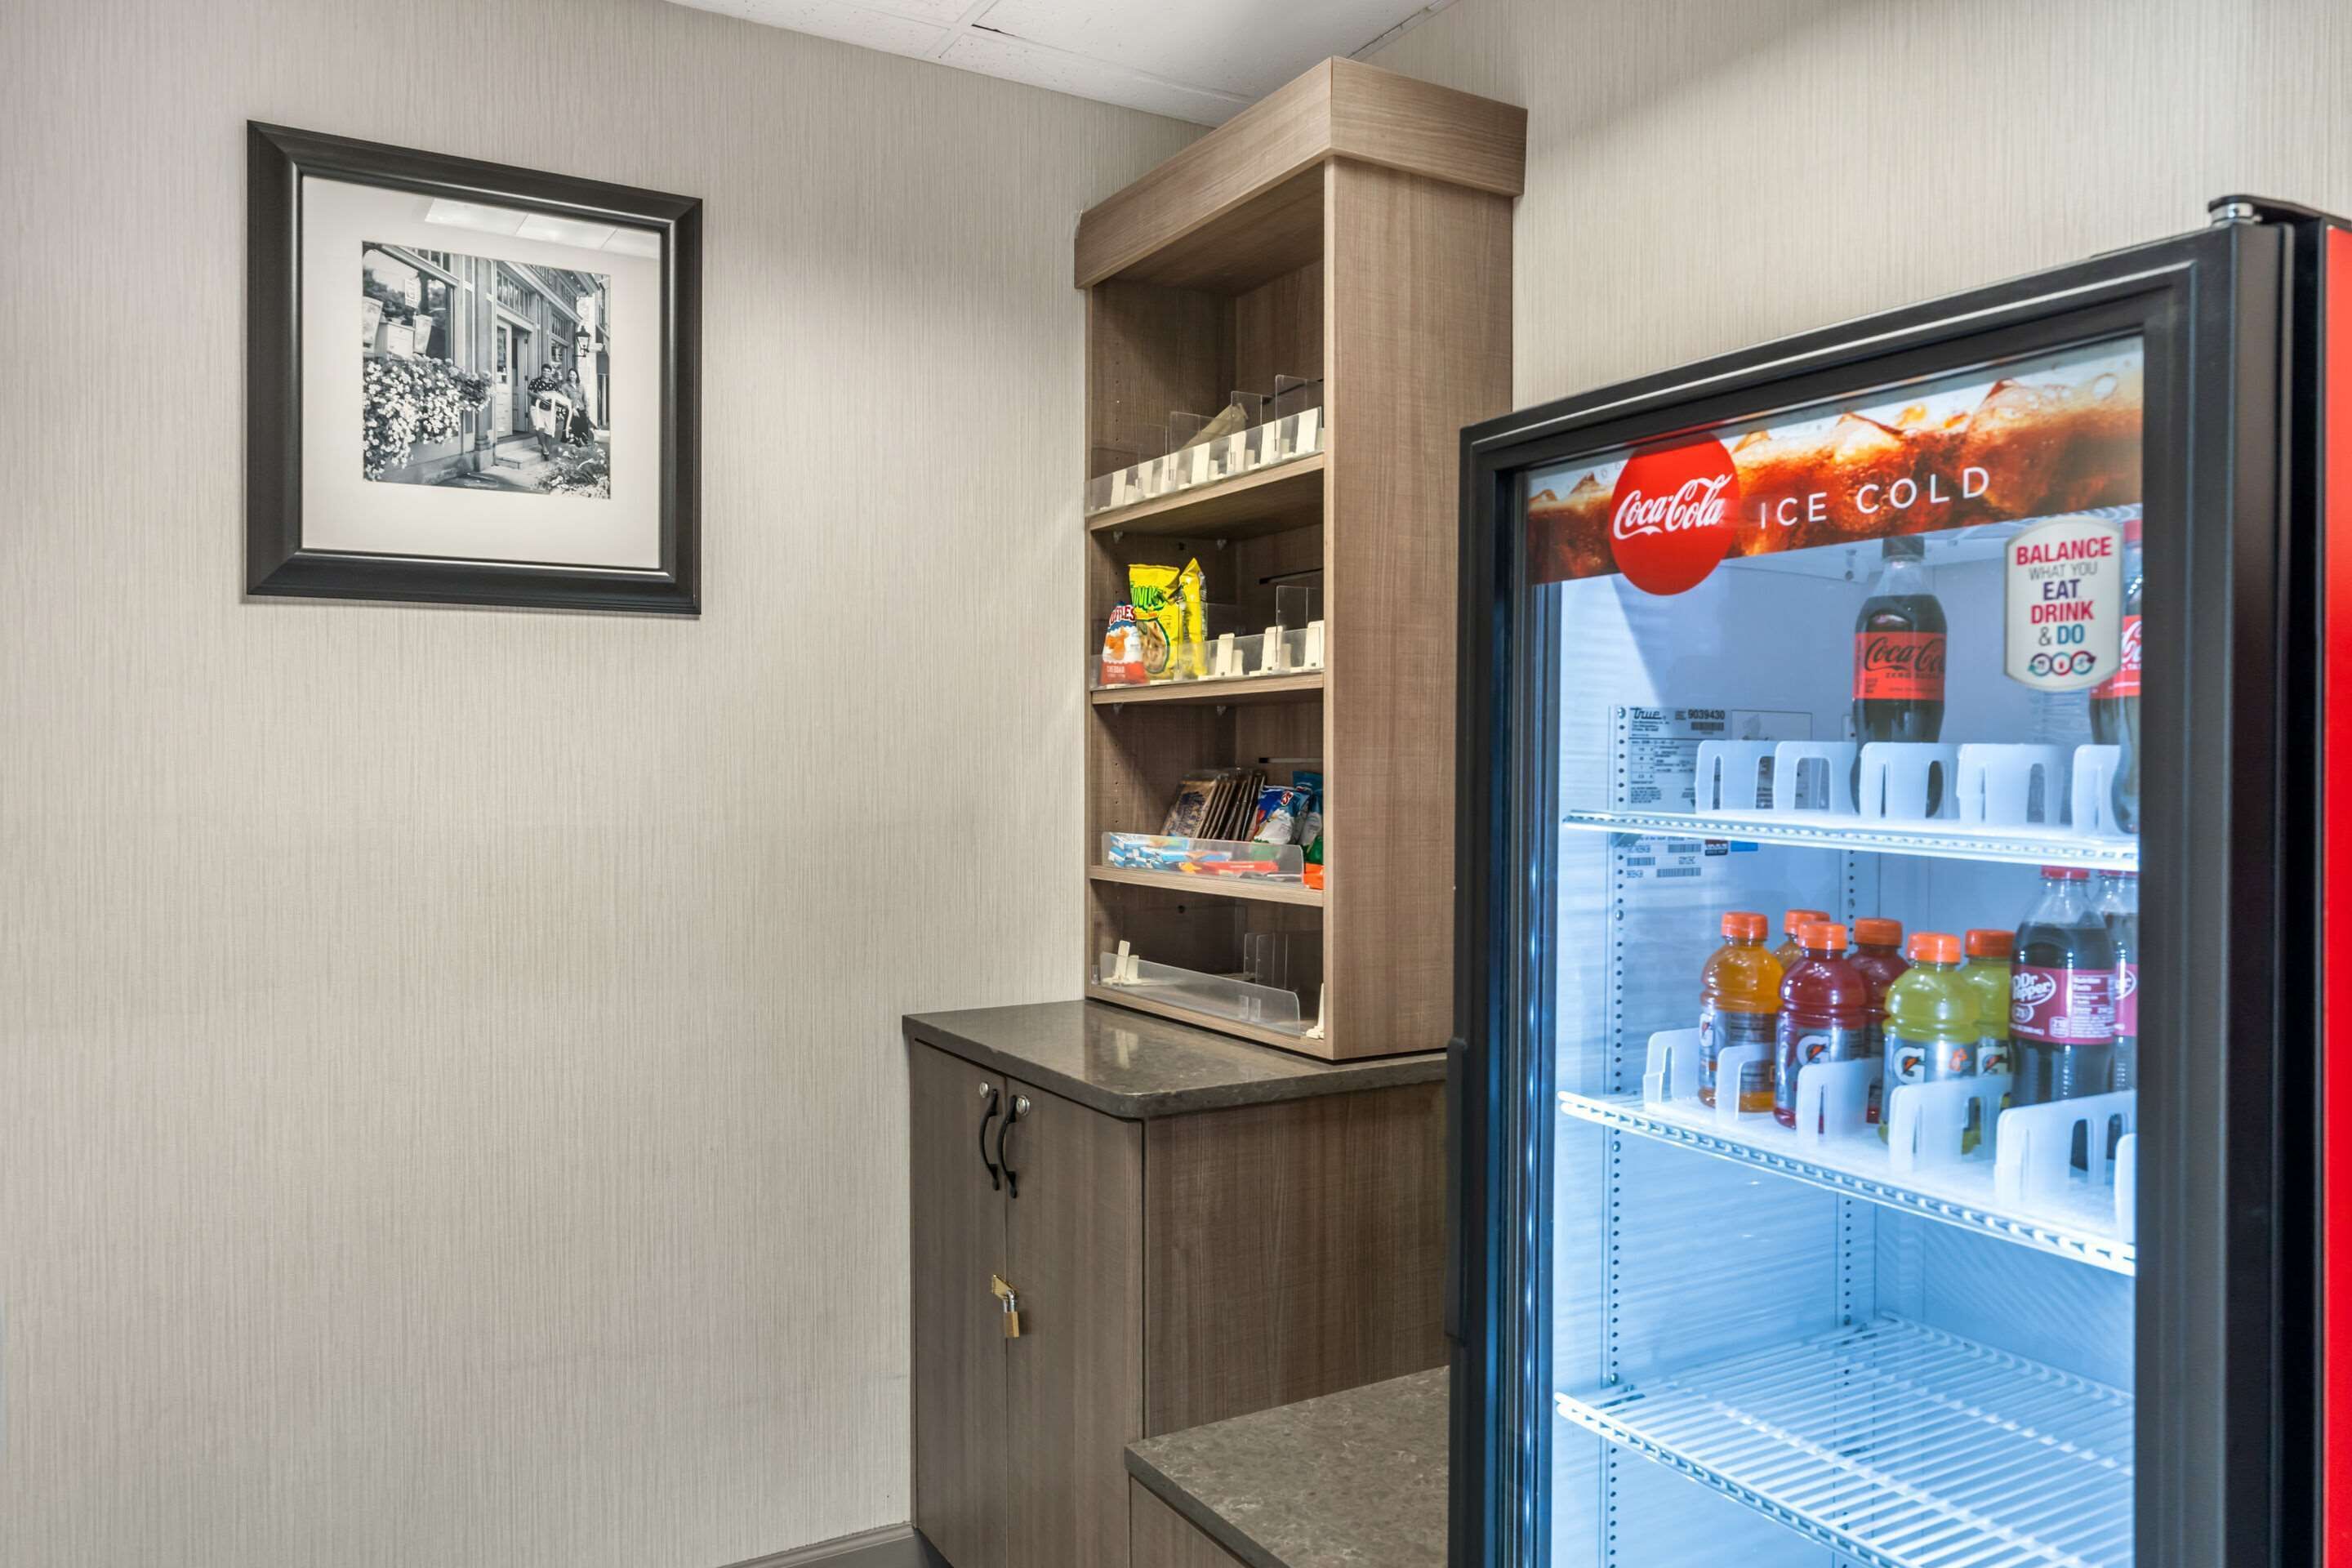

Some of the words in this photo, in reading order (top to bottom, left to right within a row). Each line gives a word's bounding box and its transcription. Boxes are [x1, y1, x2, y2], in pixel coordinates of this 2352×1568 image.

[1613, 473, 1732, 540] Coca-Cola
[1760, 492, 1828, 528] ICE
[1855, 466, 1990, 515] COLD
[2016, 537, 2113, 565] BALANCE
[2028, 564, 2065, 580] WHAT
[2072, 561, 2098, 576] YOU
[2042, 578, 2080, 600] EAT
[2030, 600, 2095, 624] DRINK
[2038, 626, 2051, 646] &
[2056, 623, 2085, 644] DO
[1630, 707, 1663, 719] True
[1687, 708, 1726, 720] 9039430
[1797, 1035, 1830, 1065] G
[1893, 1046, 1926, 1085] G
